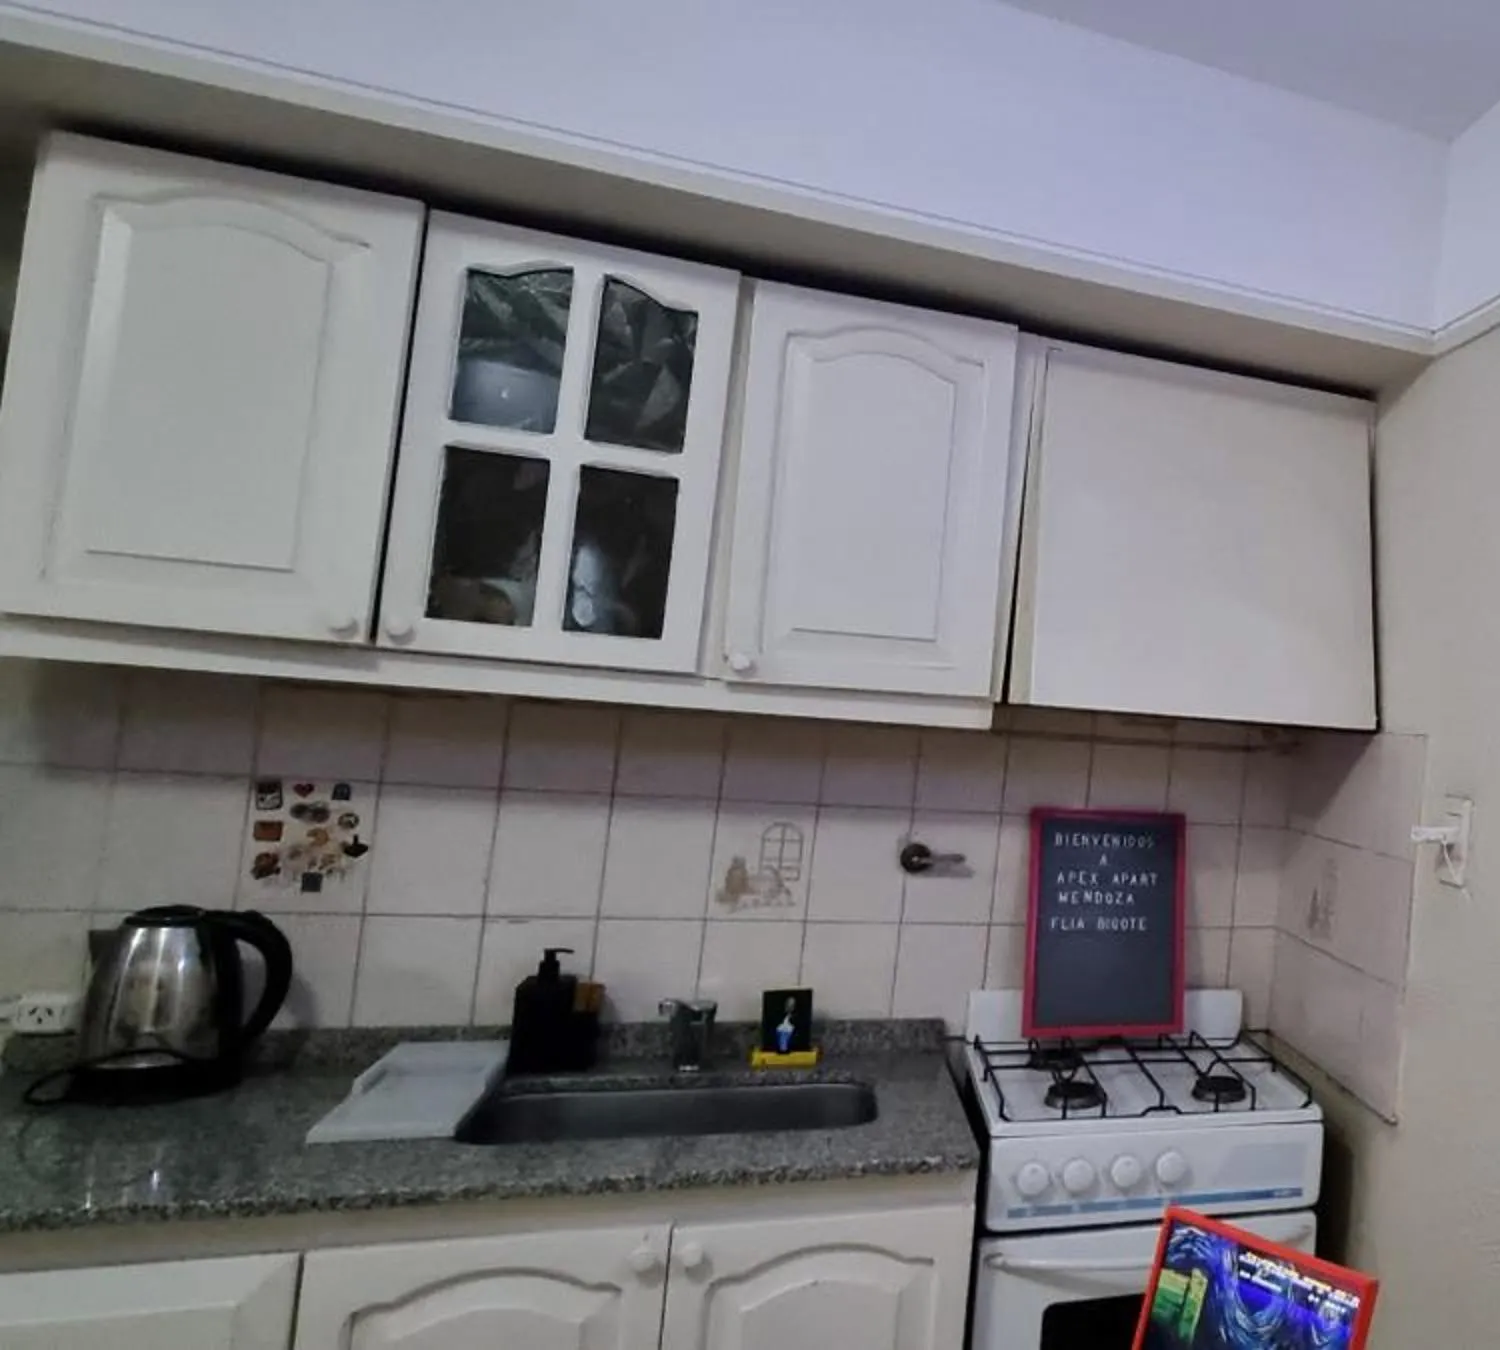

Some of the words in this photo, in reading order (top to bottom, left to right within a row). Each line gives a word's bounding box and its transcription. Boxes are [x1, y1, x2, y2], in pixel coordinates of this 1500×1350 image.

[1054, 831, 1155, 849] BIENVENIDOS
[1099, 853, 1108, 866] A
[1056, 870, 1099, 886] APEX
[1111, 871, 1159, 887] APART
[1058, 890, 1135, 906] MENDOZA
[1050, 916, 1085, 931] FLIA
